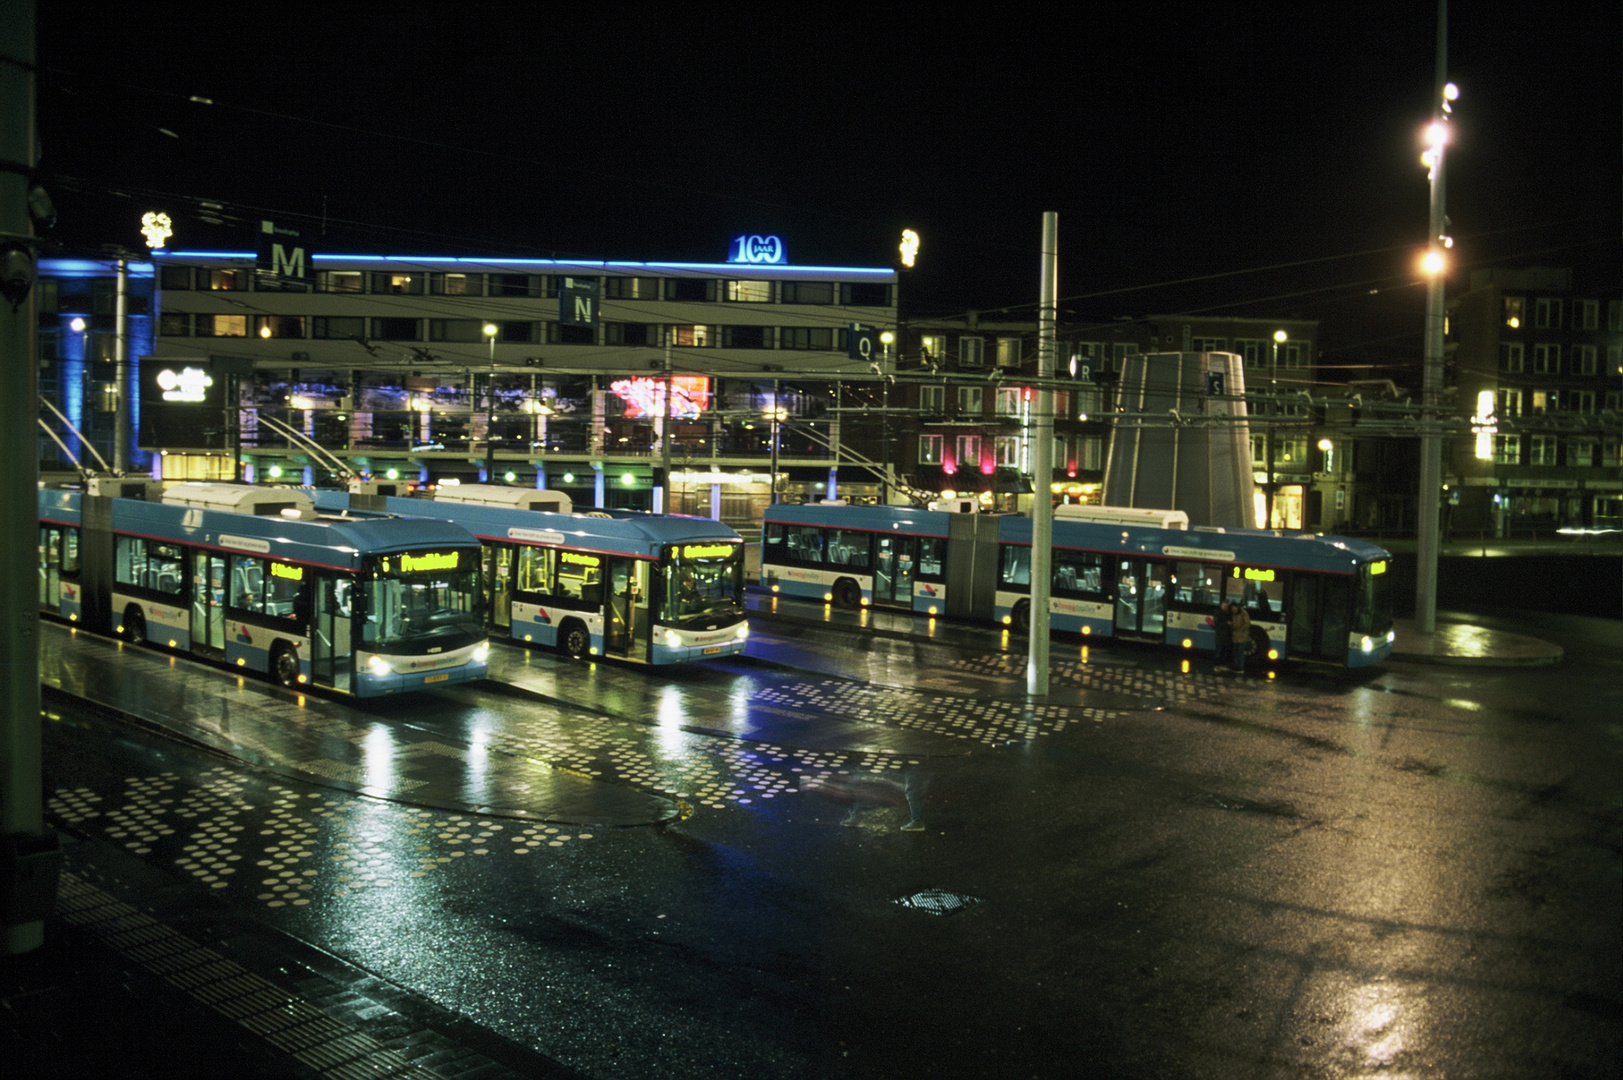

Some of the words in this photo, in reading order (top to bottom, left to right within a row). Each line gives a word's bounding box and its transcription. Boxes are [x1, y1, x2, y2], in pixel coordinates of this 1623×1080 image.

[734, 234, 782, 263] 100
[754, 245, 774, 253] JAAR
[272, 243, 305, 278] M
[575, 296, 592, 323] N
[859, 337, 871, 361] Q
[1082, 365, 1090, 381] R
[1213, 381, 1220, 395] S
[561, 552, 568, 563] 7
[671, 546, 679, 559] 7
